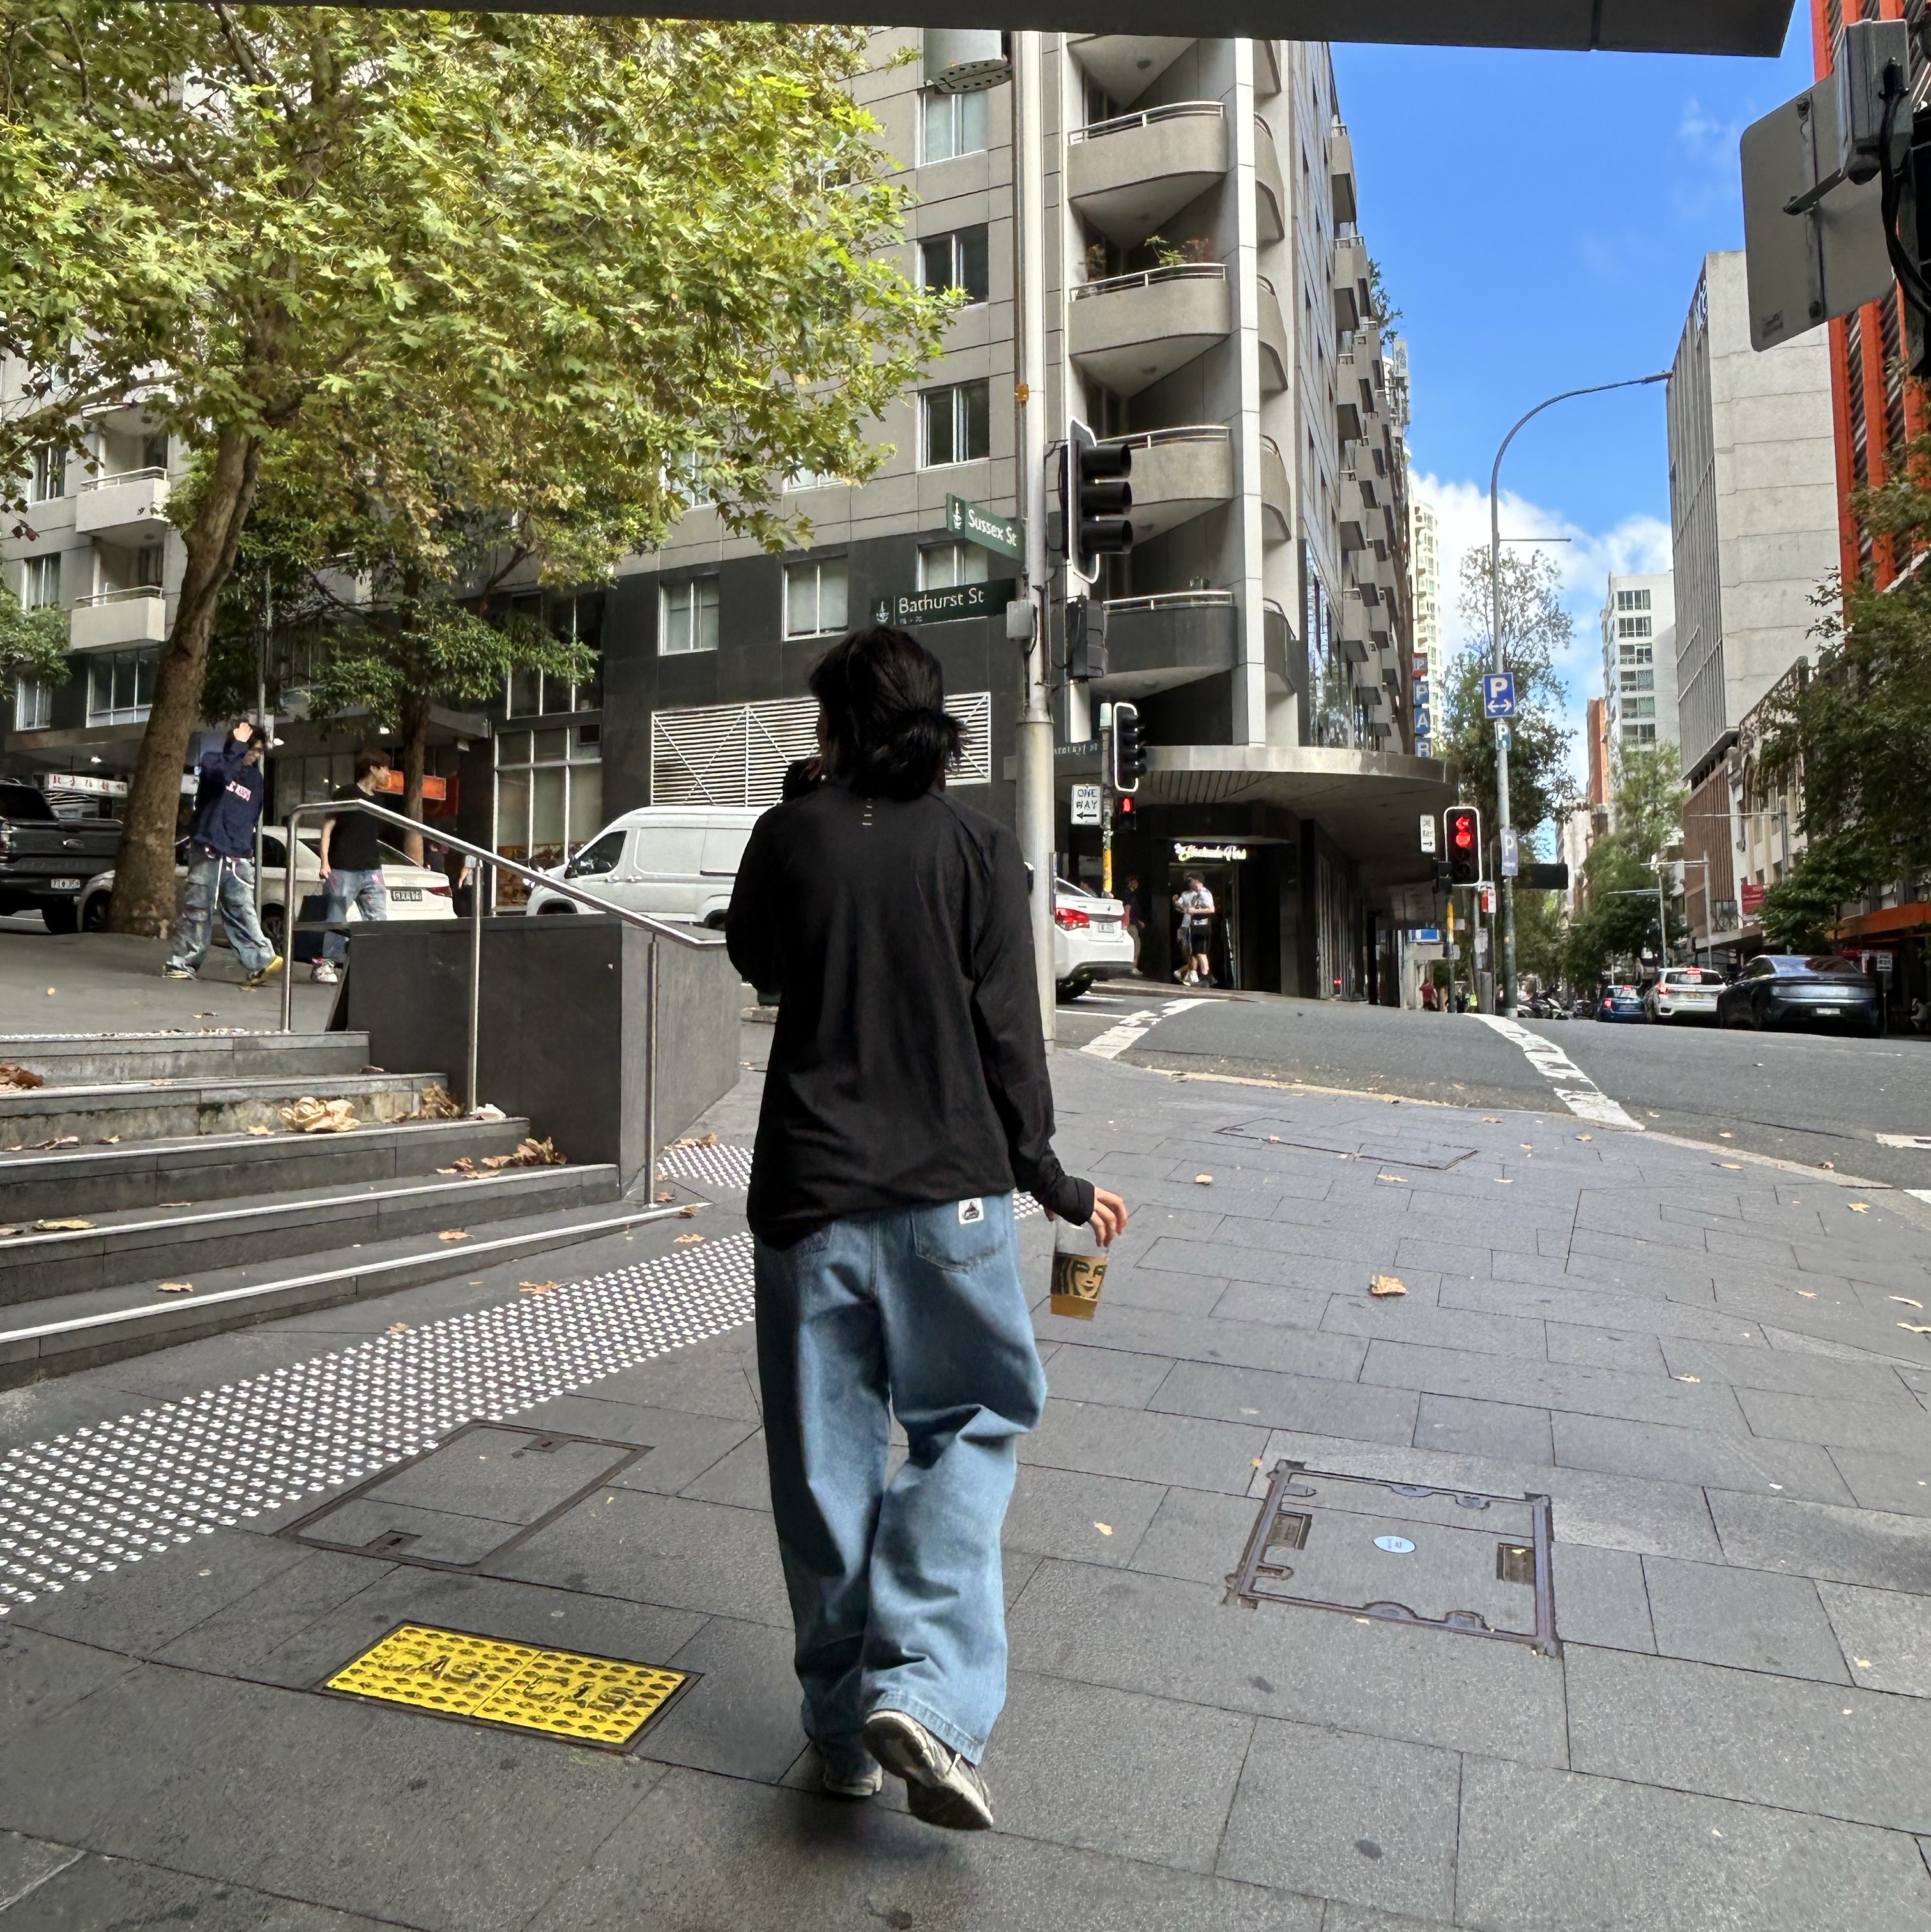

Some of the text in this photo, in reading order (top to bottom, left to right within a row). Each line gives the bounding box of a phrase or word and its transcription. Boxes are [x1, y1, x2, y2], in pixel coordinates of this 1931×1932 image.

[968, 509, 1016, 546] Sussex St
[899, 588, 984, 614] Bathurst St
[1490, 678, 1508, 698] P
[1077, 789, 1097, 798] ONE
